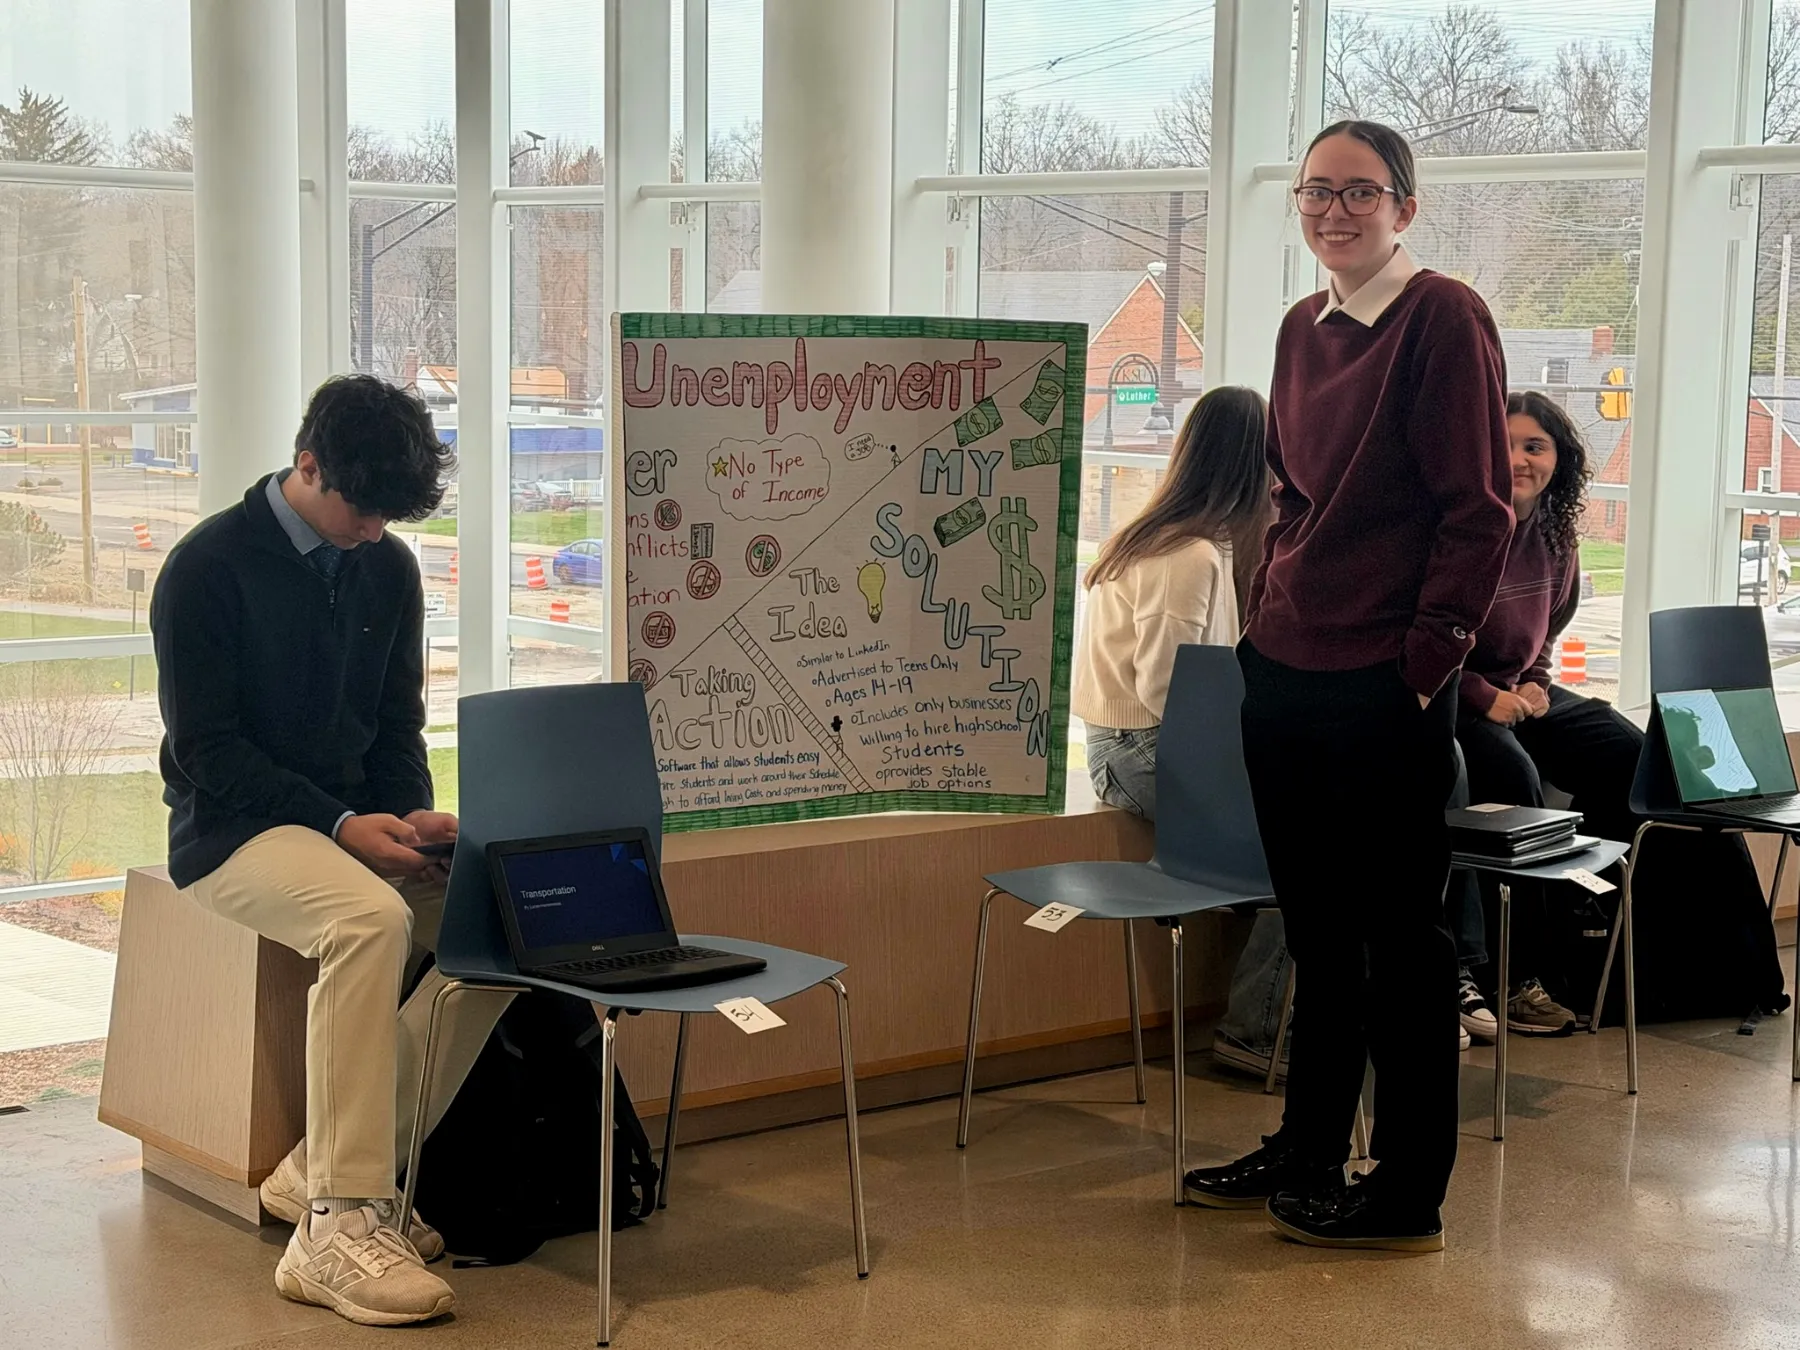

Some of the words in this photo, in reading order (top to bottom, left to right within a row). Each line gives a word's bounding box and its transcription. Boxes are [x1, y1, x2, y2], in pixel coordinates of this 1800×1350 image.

[623, 336, 1002, 435] Unemployment
[1126, 391, 1151, 401] Luther
[626, 449, 678, 497] er
[729, 451, 756, 480] No
[762, 449, 805, 477] Type
[919, 448, 1004, 497] MY
[732, 480, 750, 499] of
[762, 480, 825, 503] Income
[789, 567, 841, 597] The
[767, 601, 848, 643] Idea
[870, 502, 1050, 758] SOLUTION
[801, 652, 833, 668] Similar
[835, 650, 845, 660] to
[817, 663, 877, 687] Advertised
[880, 660, 894, 674] to
[895, 656, 928, 673] Teens
[930, 654, 959, 673] Only
[670, 665, 756, 709] Taking
[834, 687, 867, 707] Ages
[856, 704, 909, 726] Includes
[914, 696, 944, 714] only
[948, 695, 1012, 711] businesses
[904, 722, 919, 738] to
[924, 719, 951, 735] hire
[657, 758, 697, 773] Software
[700, 756, 719, 770] that
[723, 755, 751, 768] allows
[797, 751, 820, 766] easy
[718, 772, 734, 786] and
[738, 773, 758, 785] work
[761, 769, 786, 783] around
[788, 769, 806, 781] their
[883, 763, 933, 786] provides
[678, 794, 690, 808] to
[694, 790, 721, 805] afford
[766, 788, 781, 799] and
[783, 784, 820, 797] spending
[521, 886, 577, 899] Transportation
[730, 1004, 764, 1022] 54
